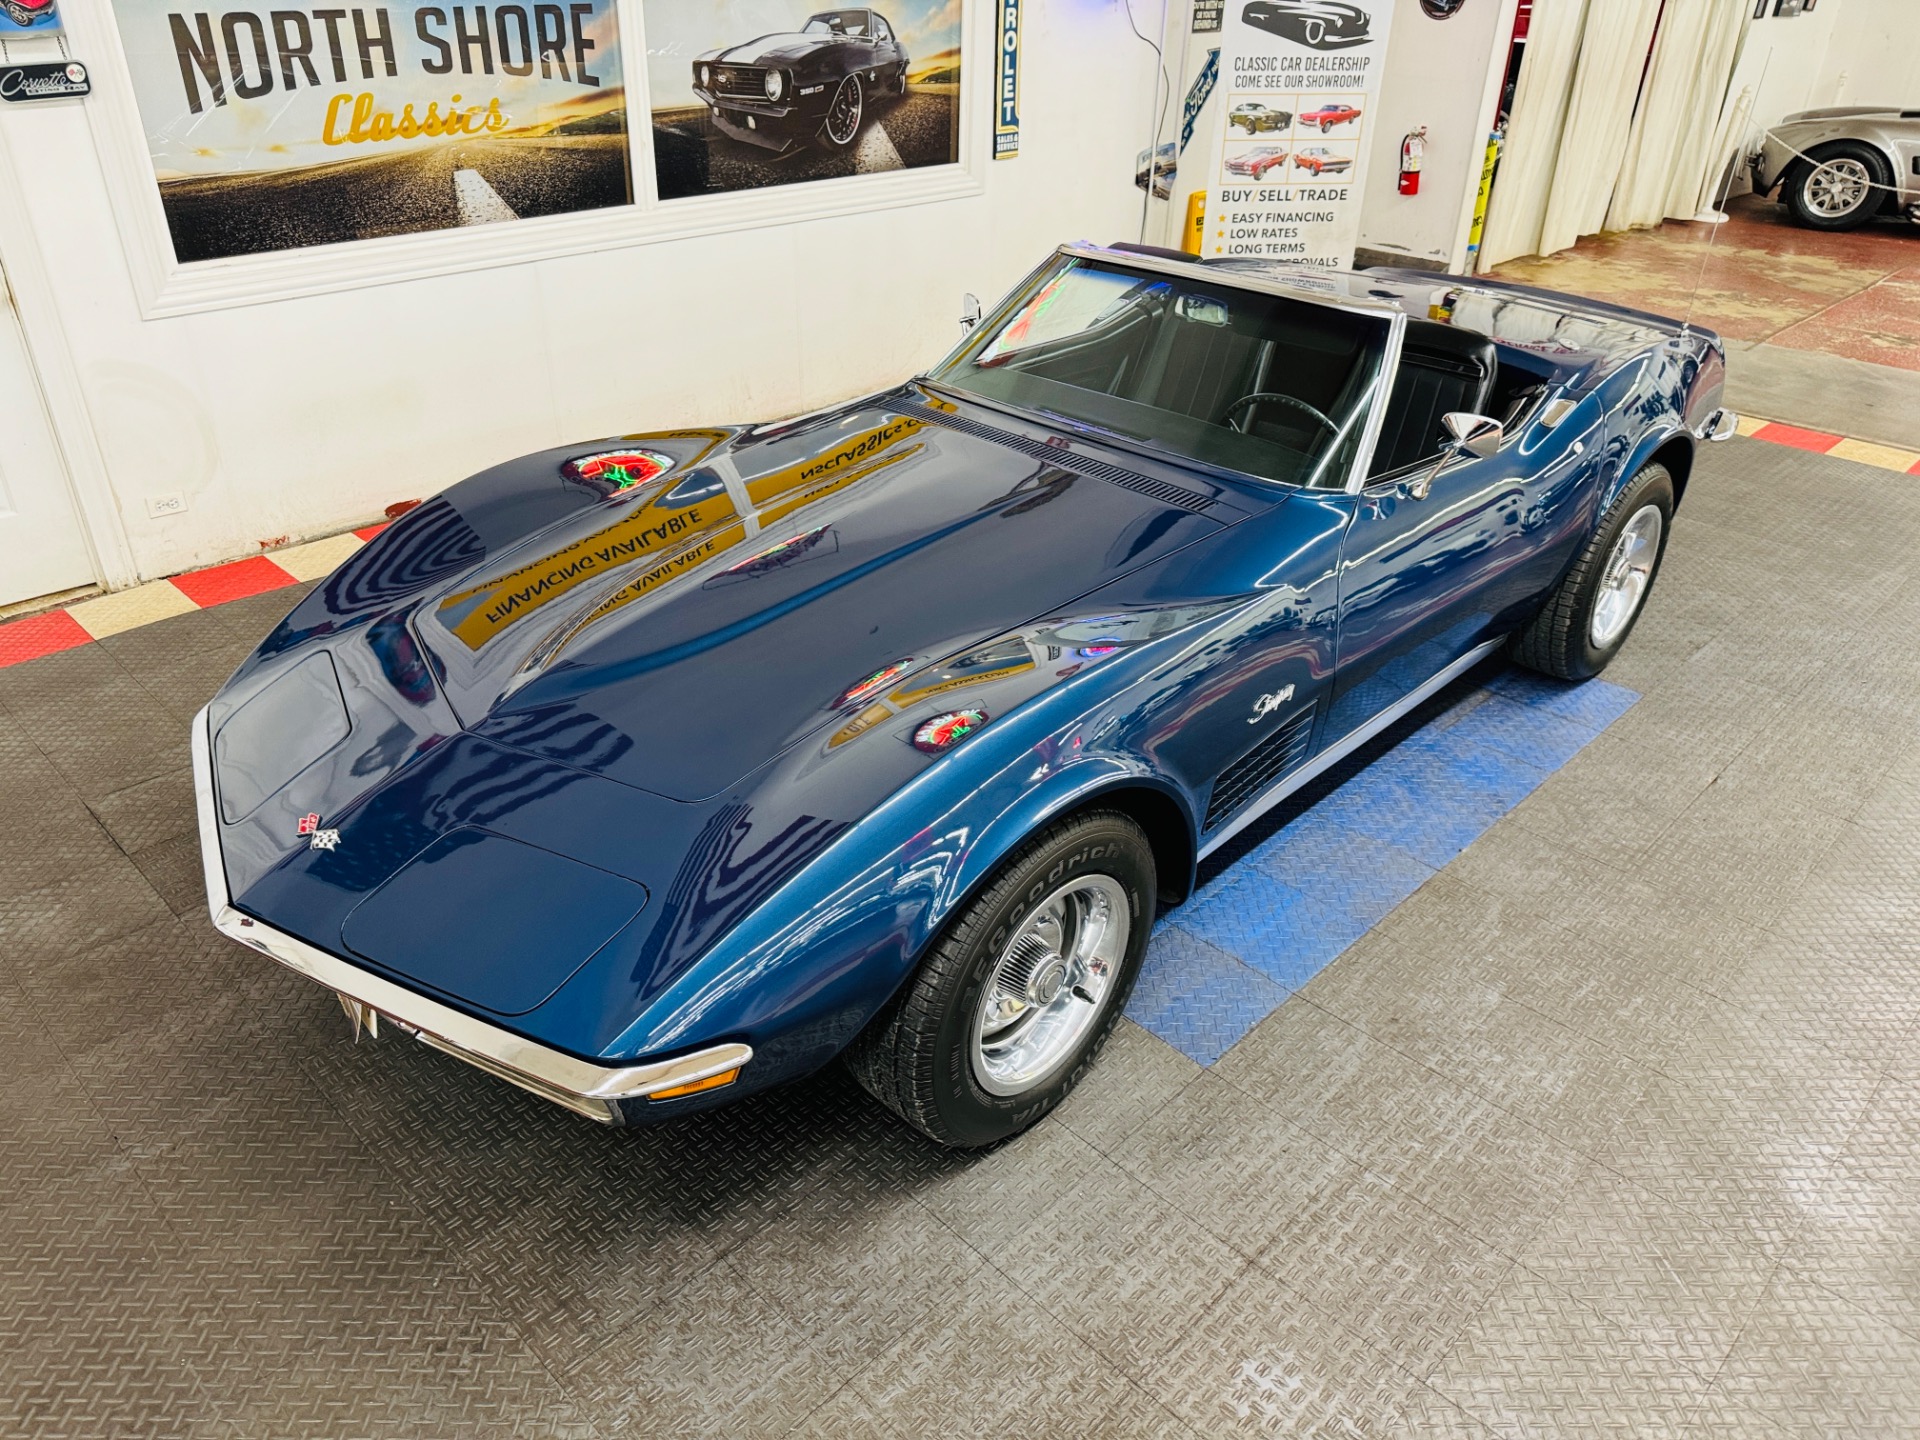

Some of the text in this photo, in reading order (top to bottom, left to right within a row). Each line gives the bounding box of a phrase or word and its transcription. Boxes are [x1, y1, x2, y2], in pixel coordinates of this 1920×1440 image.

[168, 3, 600, 114] NORTH SHORE
[1003, 0, 1018, 121] ROLET
[1234, 57, 1278, 71] CLASSIC
[1280, 57, 1302, 71] CAR
[1305, 56, 1370, 71] DEALERSHIP
[0, 69, 71, 96] Corvette
[1235, 75, 1364, 88] COME SEE OUR SHOWROOM!
[322, 92, 509, 146] Classics
[1232, 211, 1334, 224] EASY FINANCING
[1230, 228, 1298, 239] LOW RATES
[1228, 243, 1305, 255] LONG TERMS
[1285, 257, 1339, 267] ROVALS
